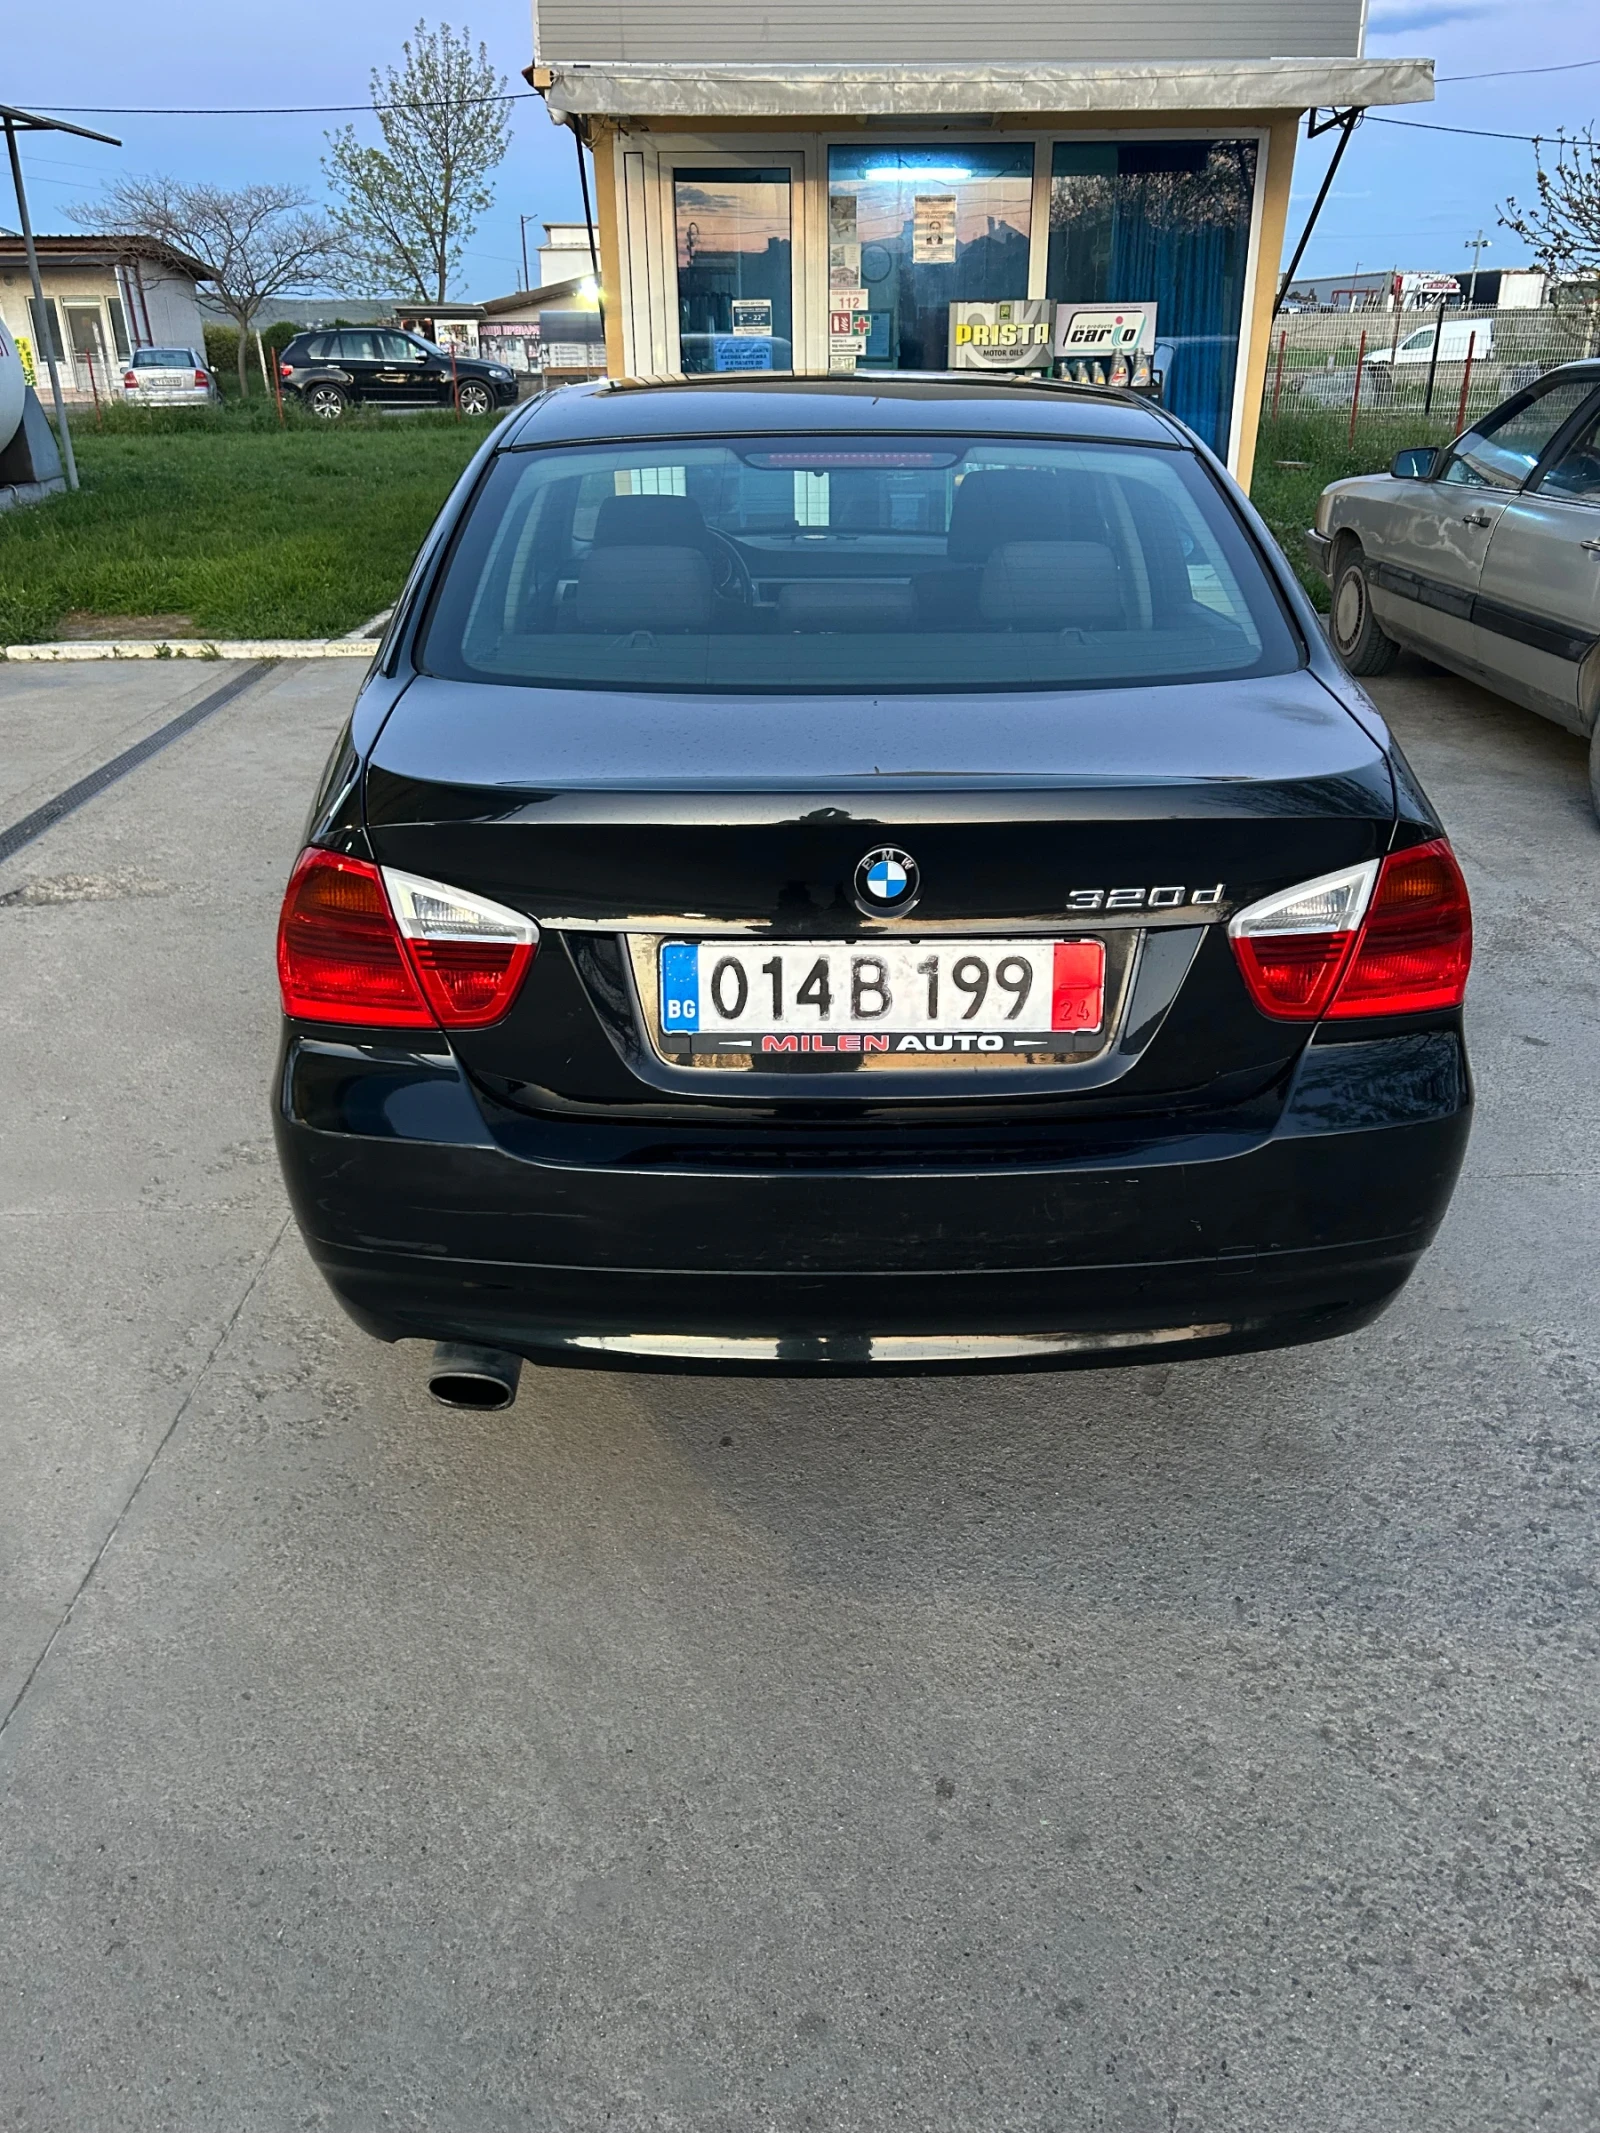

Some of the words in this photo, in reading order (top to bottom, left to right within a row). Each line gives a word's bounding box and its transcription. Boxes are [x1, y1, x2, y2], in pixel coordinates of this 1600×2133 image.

[839, 297, 860, 309] 112
[955, 323, 1050, 347] PRISTA
[1070, 316, 1137, 348] cario
[861, 850, 915, 871] BMW
[1066, 883, 1226, 910] 320d
[668, 999, 696, 1019] BG
[1060, 1000, 1090, 1021] 24
[761, 1034, 890, 1052] MILEN
[895, 1034, 1004, 1052] AUTO
